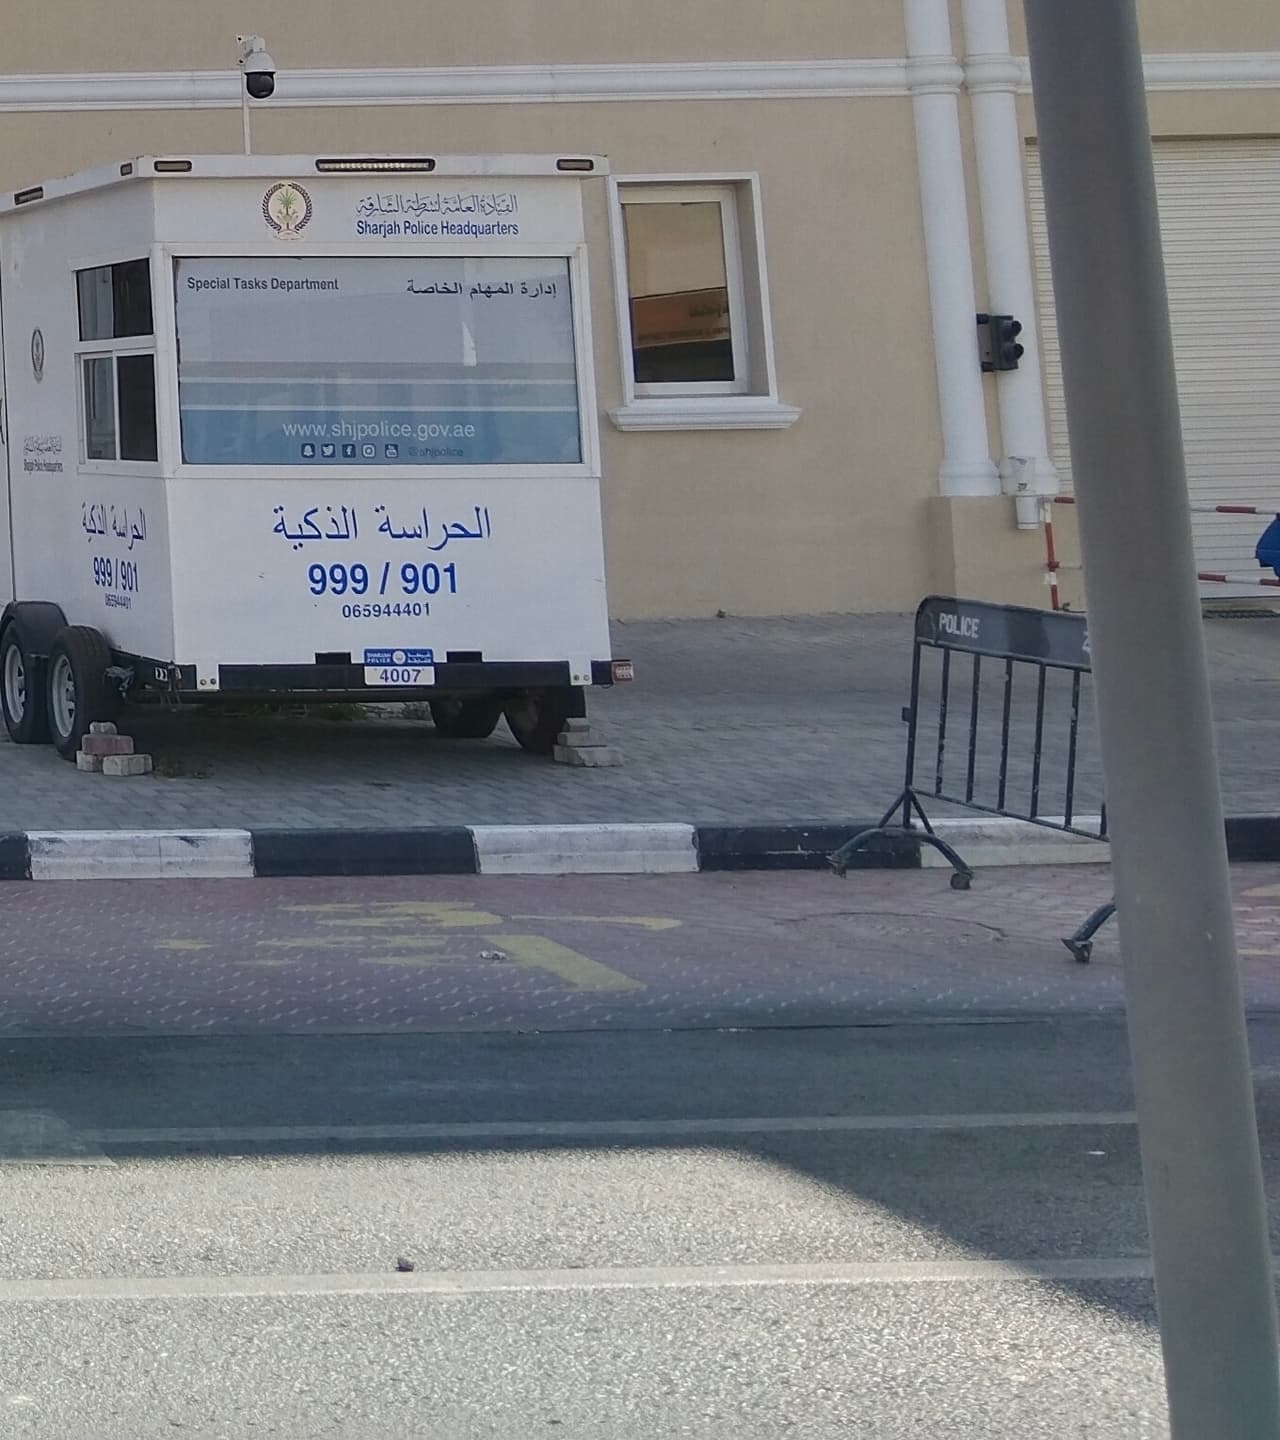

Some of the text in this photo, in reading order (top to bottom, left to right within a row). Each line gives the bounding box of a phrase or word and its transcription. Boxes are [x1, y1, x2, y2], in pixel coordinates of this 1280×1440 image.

[356, 220, 519, 238] Sharjah Police Headquarters
[187, 276, 340, 292] Special Tasks Department
[406, 278, 558, 299] إدارة المهام الخاصة
[282, 420, 476, 441] www.shjpolice.gov.ae
[272, 505, 491, 551] الحراسة الذكية
[93, 556, 113, 587] 999
[121, 560, 139, 593] 901
[307, 561, 458, 596] 999 / 901
[341, 602, 431, 619] 065944401
[939, 612, 981, 639] POLICE
[378, 667, 423, 684] 4007
